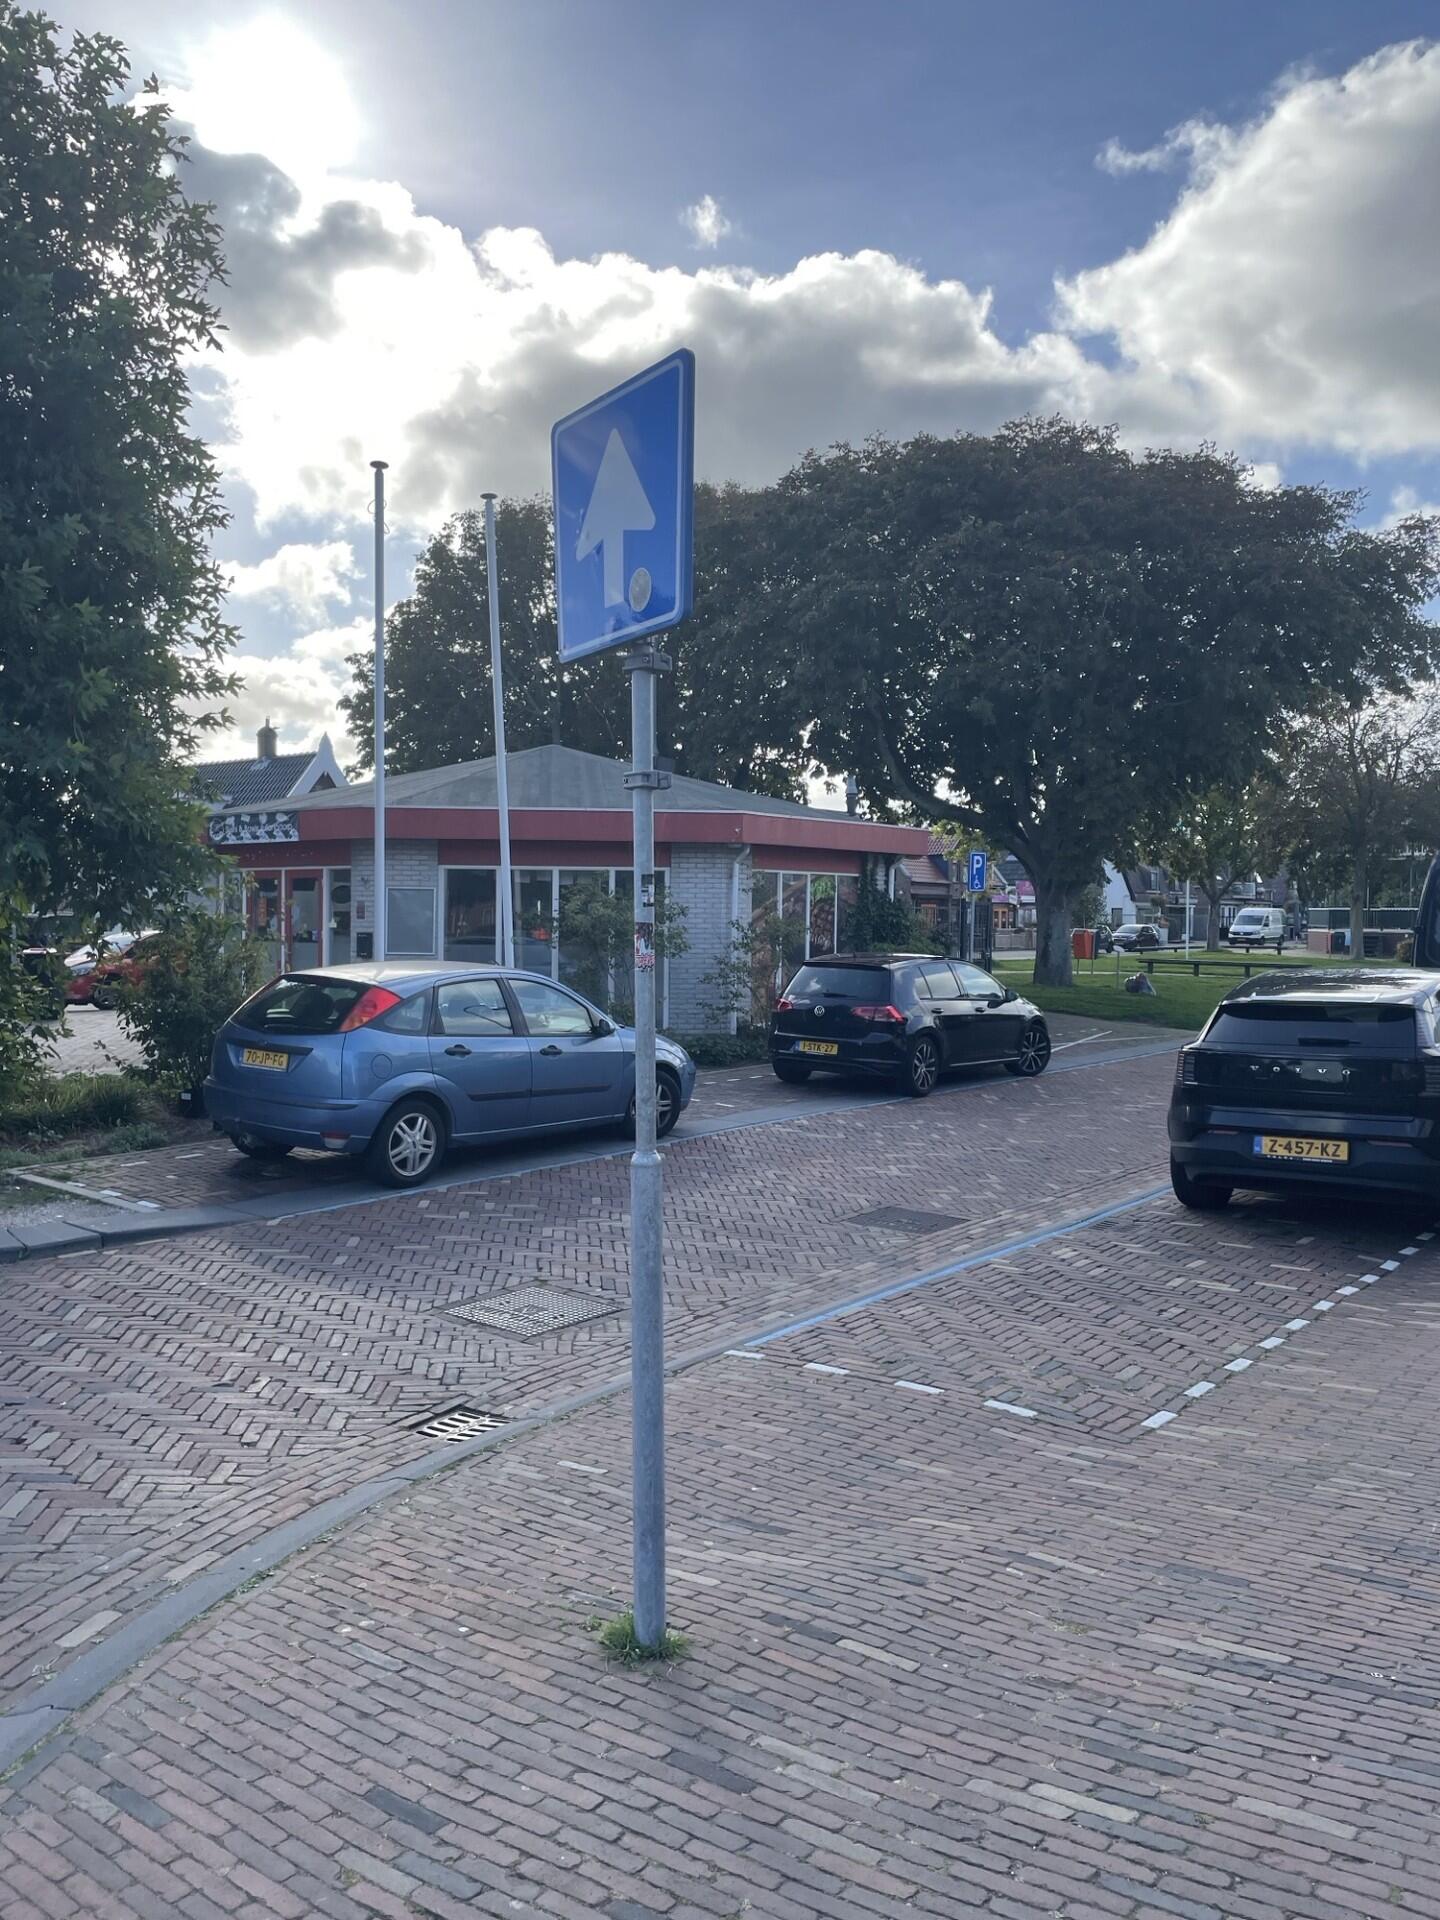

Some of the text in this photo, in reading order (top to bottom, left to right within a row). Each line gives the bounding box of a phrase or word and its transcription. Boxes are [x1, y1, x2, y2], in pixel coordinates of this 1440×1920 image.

[973, 855, 983, 876] P
[246, 1050, 285, 1067] 70-JP-FG
[1249, 1064, 1351, 1076] VOLVO
[1268, 1139, 1341, 1158] Z-457-KZ
